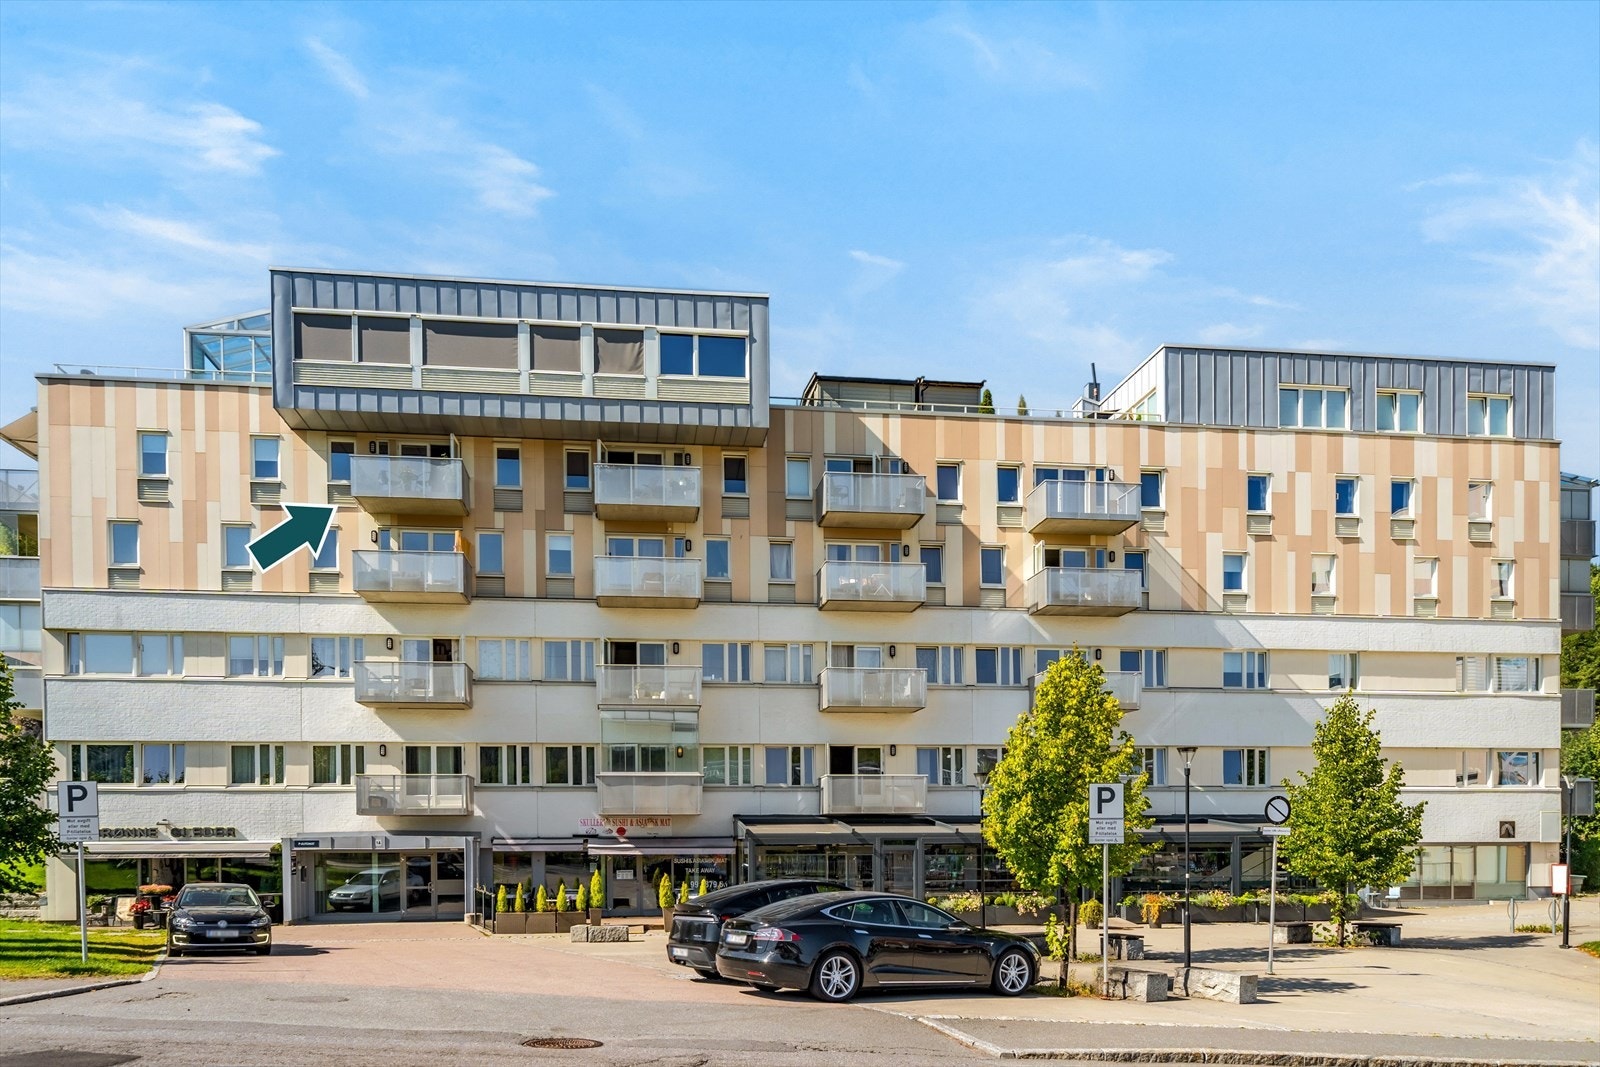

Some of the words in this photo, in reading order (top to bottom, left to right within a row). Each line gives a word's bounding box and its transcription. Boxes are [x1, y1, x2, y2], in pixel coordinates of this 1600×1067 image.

[67, 785, 88, 812] P
[1097, 787, 1115, 814] P
[99, 827, 159, 838] RØNNE
